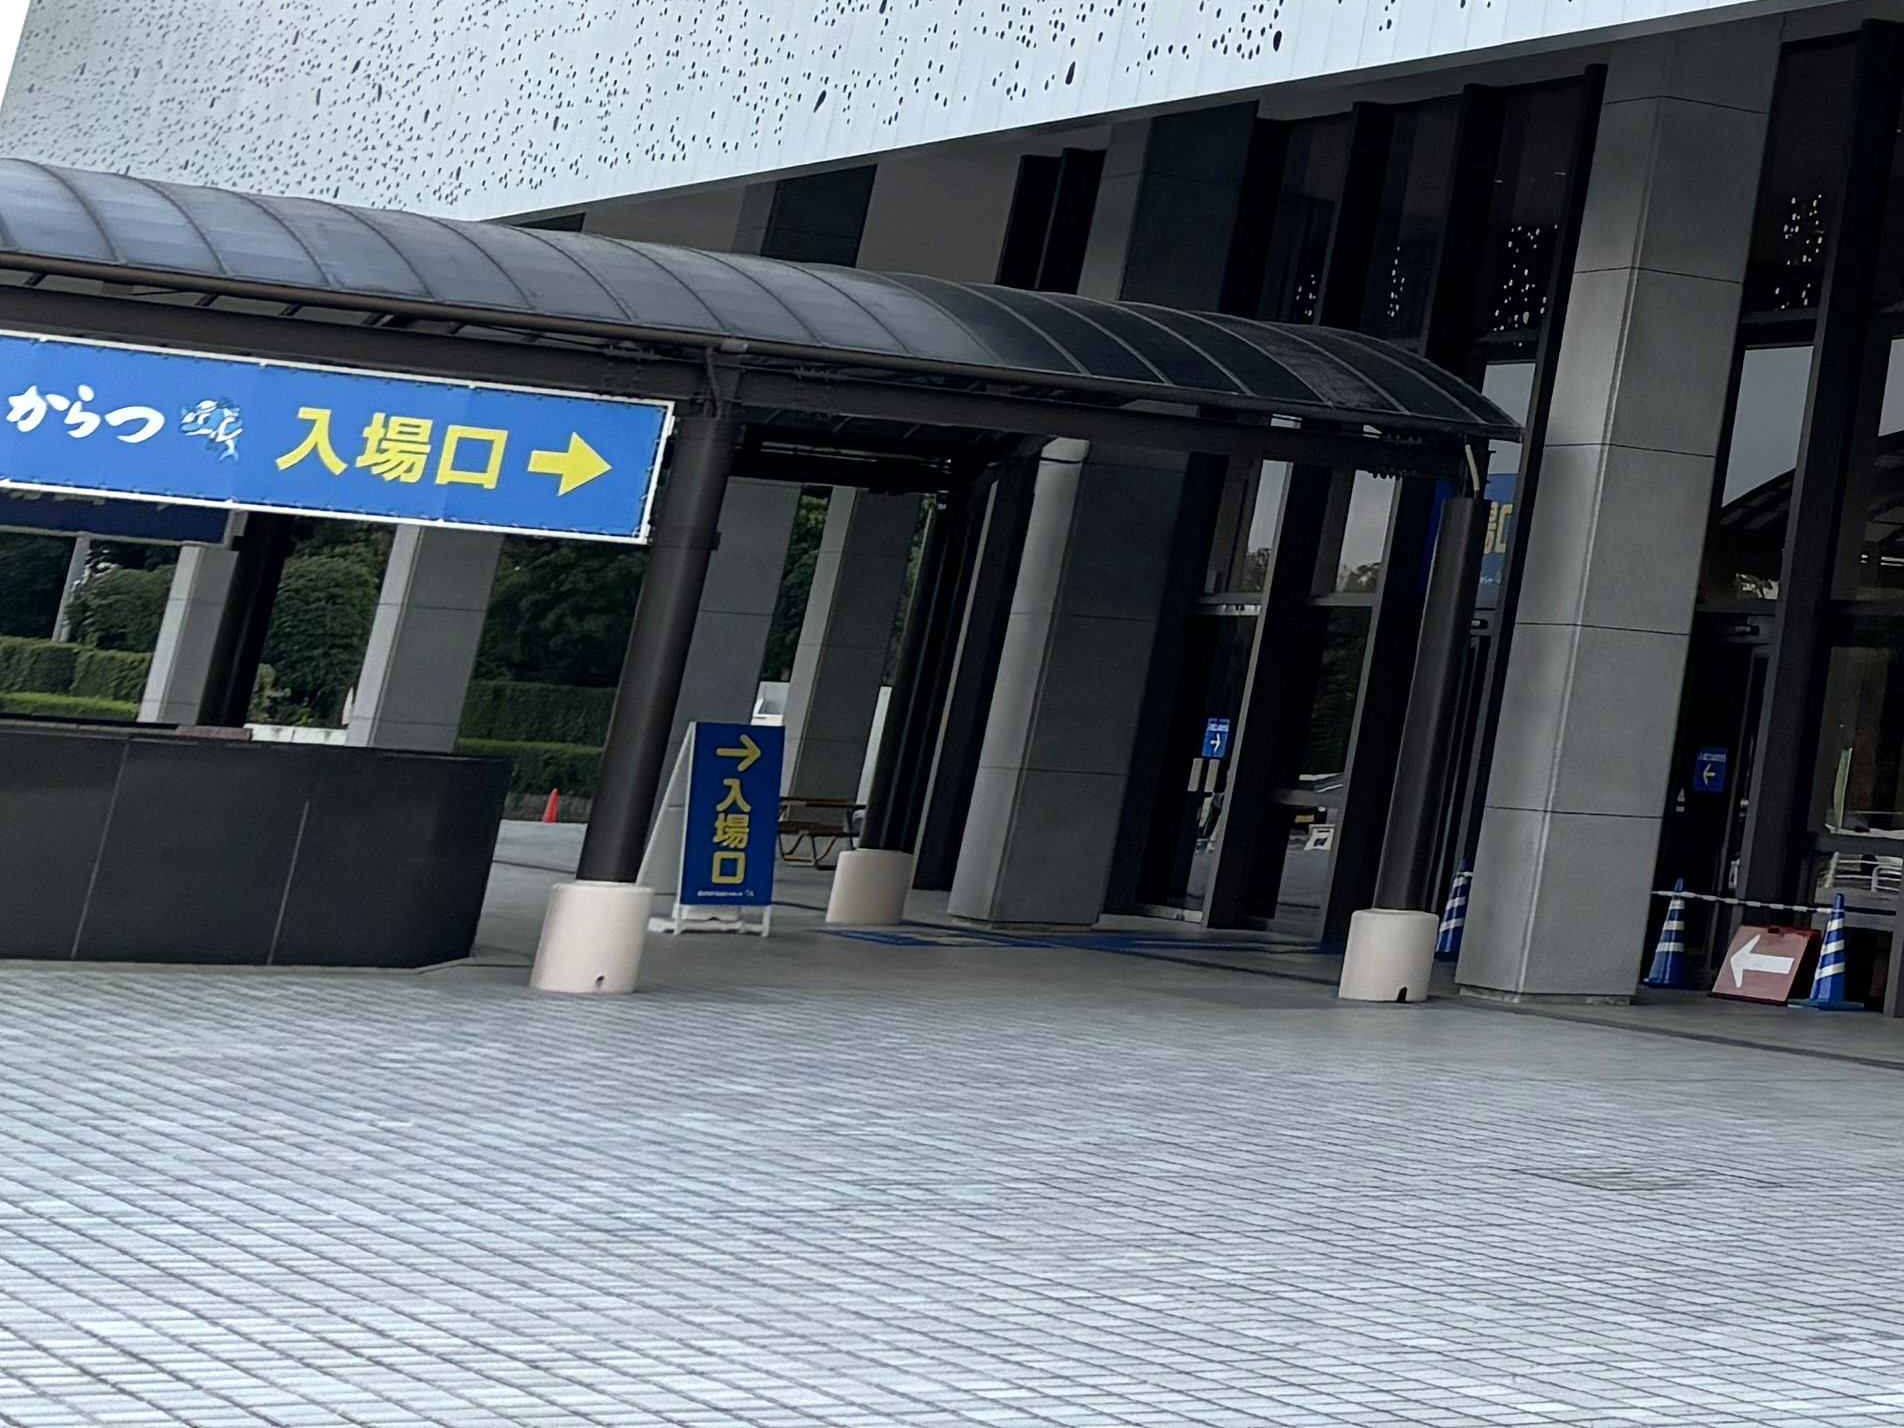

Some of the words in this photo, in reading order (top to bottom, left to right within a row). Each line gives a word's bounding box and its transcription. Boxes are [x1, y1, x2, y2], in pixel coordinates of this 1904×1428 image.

[7, 385, 165, 443] からつ
[276, 406, 508, 489] 入場口
[711, 778, 751, 884] 入場口
